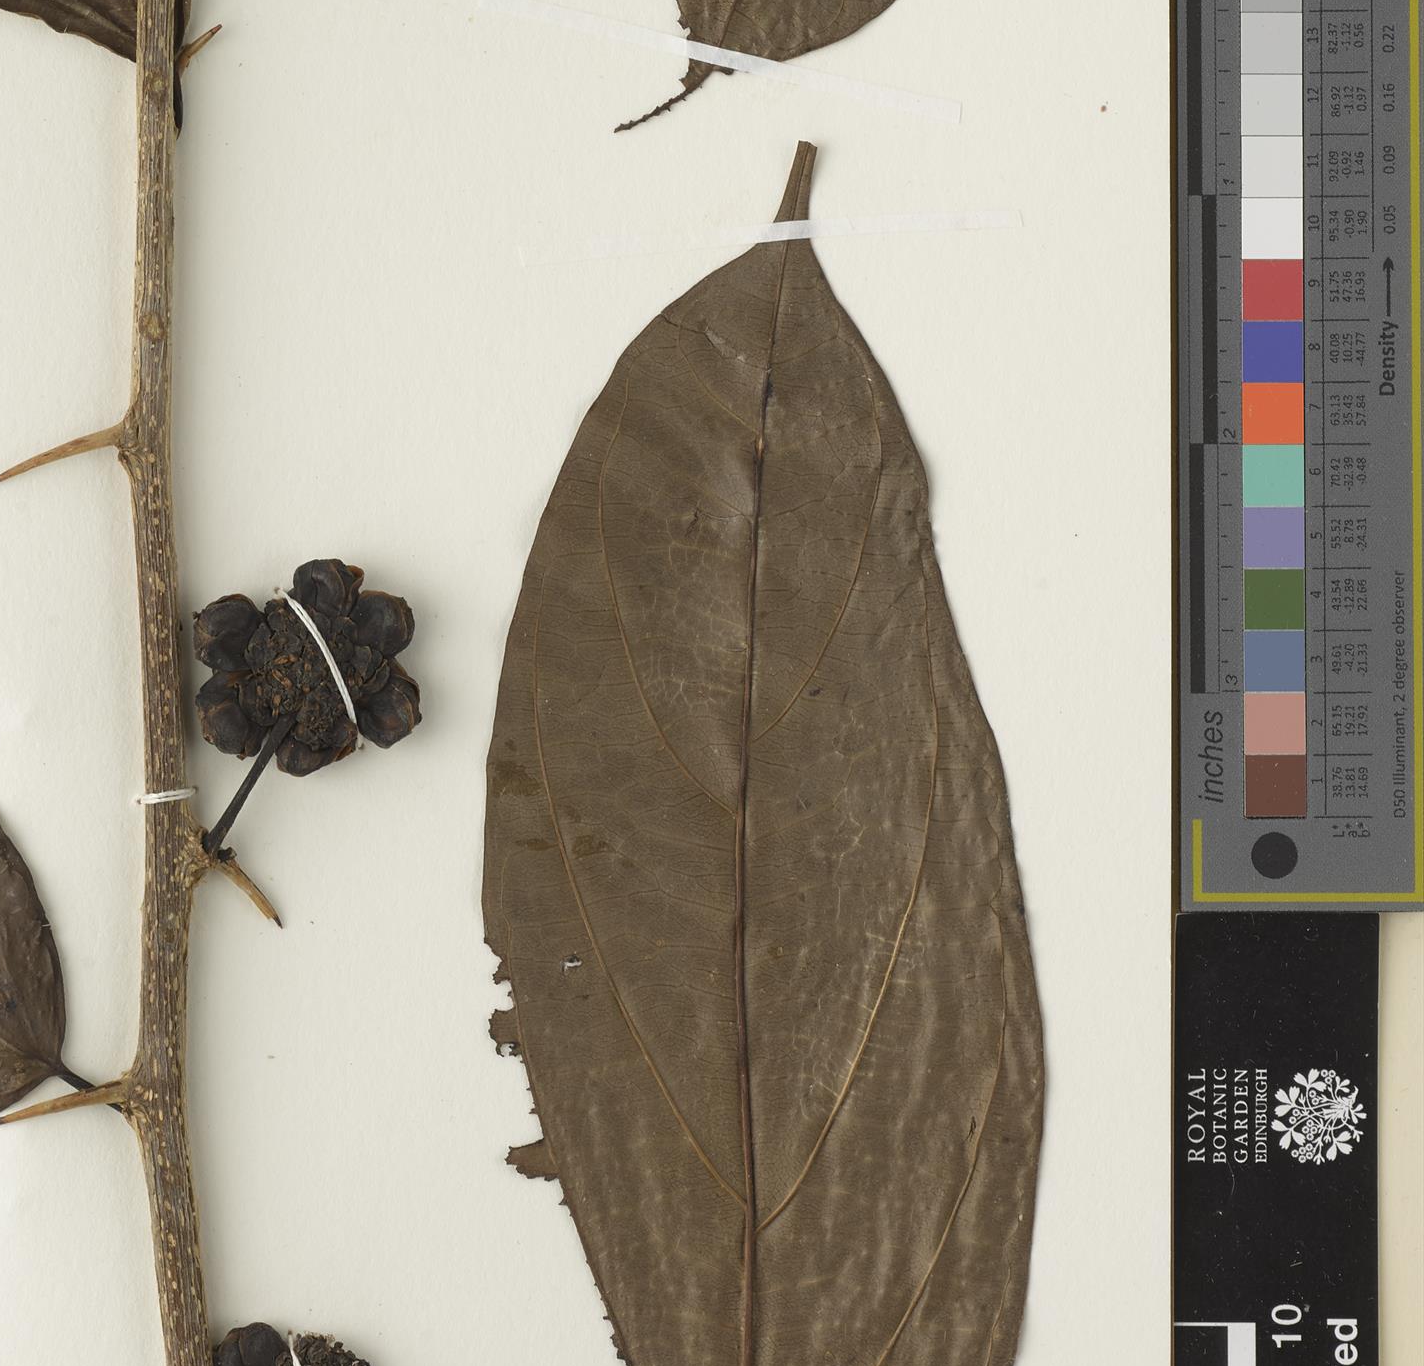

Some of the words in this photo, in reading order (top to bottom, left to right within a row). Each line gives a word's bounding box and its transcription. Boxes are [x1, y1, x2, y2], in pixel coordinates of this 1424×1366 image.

[1381, 24, 1396, 54] 0.22
[1382, 82, 1396, 113] 0.16
[1382, 145, 1396, 175] 0.09
[1382, 204, 1397, 235] 0.05
[1377, 320, 1400, 396] Density
[1391, 570, 1406, 635] observer
[1391, 638, 1409, 690] degree
[1392, 693, 1406, 703] 2
[1197, 709, 1224, 804] inches
[1391, 706, 1408, 786] Illuminant,
[1392, 788, 1407, 819] D50
[1187, 1068, 1206, 1163] ROYAL
[1212, 1068, 1227, 1164] BOTANIC
[1233, 1068, 1249, 1164] GARDEN
[1254, 1068, 1268, 1164] EDINBURGH
[1270, 1303, 1303, 1349] 10
